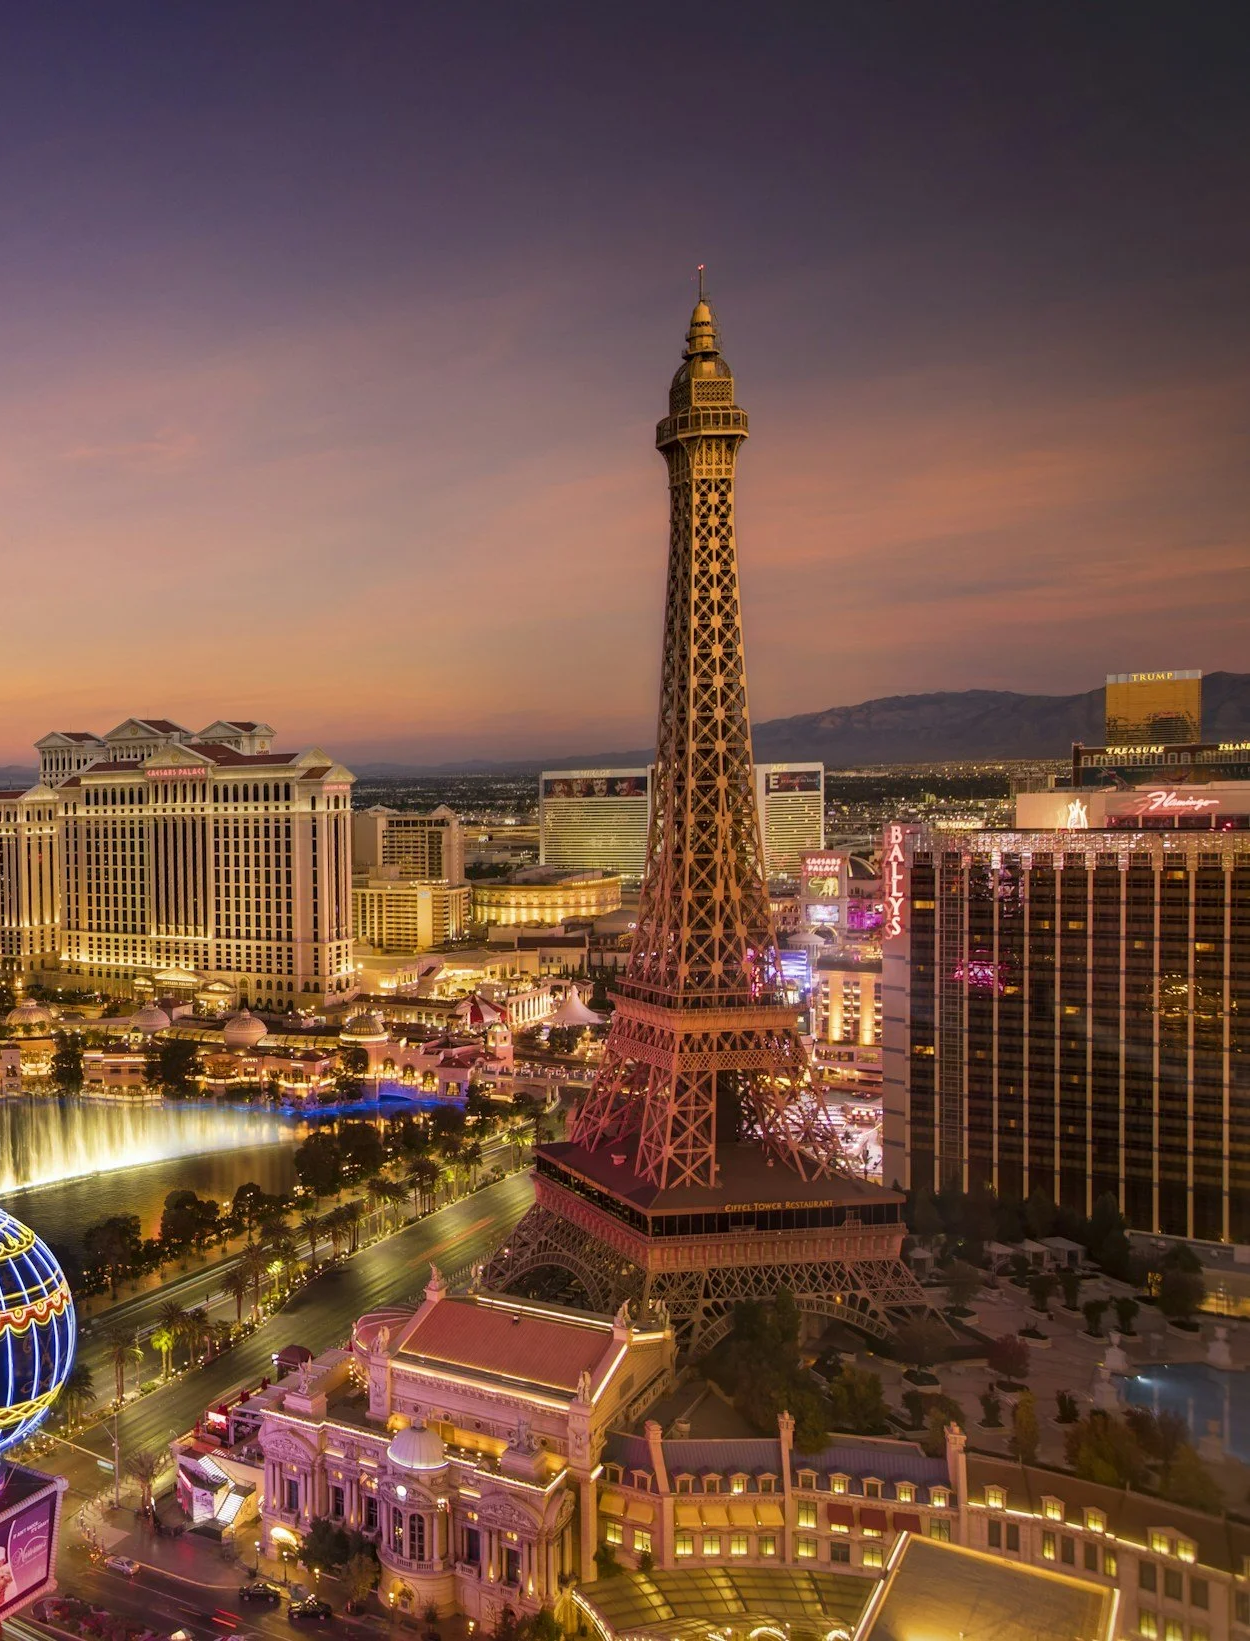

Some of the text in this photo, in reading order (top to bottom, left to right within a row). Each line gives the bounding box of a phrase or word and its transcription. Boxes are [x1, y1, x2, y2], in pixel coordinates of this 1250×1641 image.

[1131, 672, 1173, 682] TRUMP
[1105, 745, 1165, 756] TREASURE
[146, 767, 206, 777] CAESARS PALACE
[1147, 790, 1219, 811] Flamingo
[949, 821, 983, 829] MIRAGE
[806, 857, 841, 865] CAESARS
[725, 1199, 833, 1212] EIFFEL TOWER RESTAURANT
